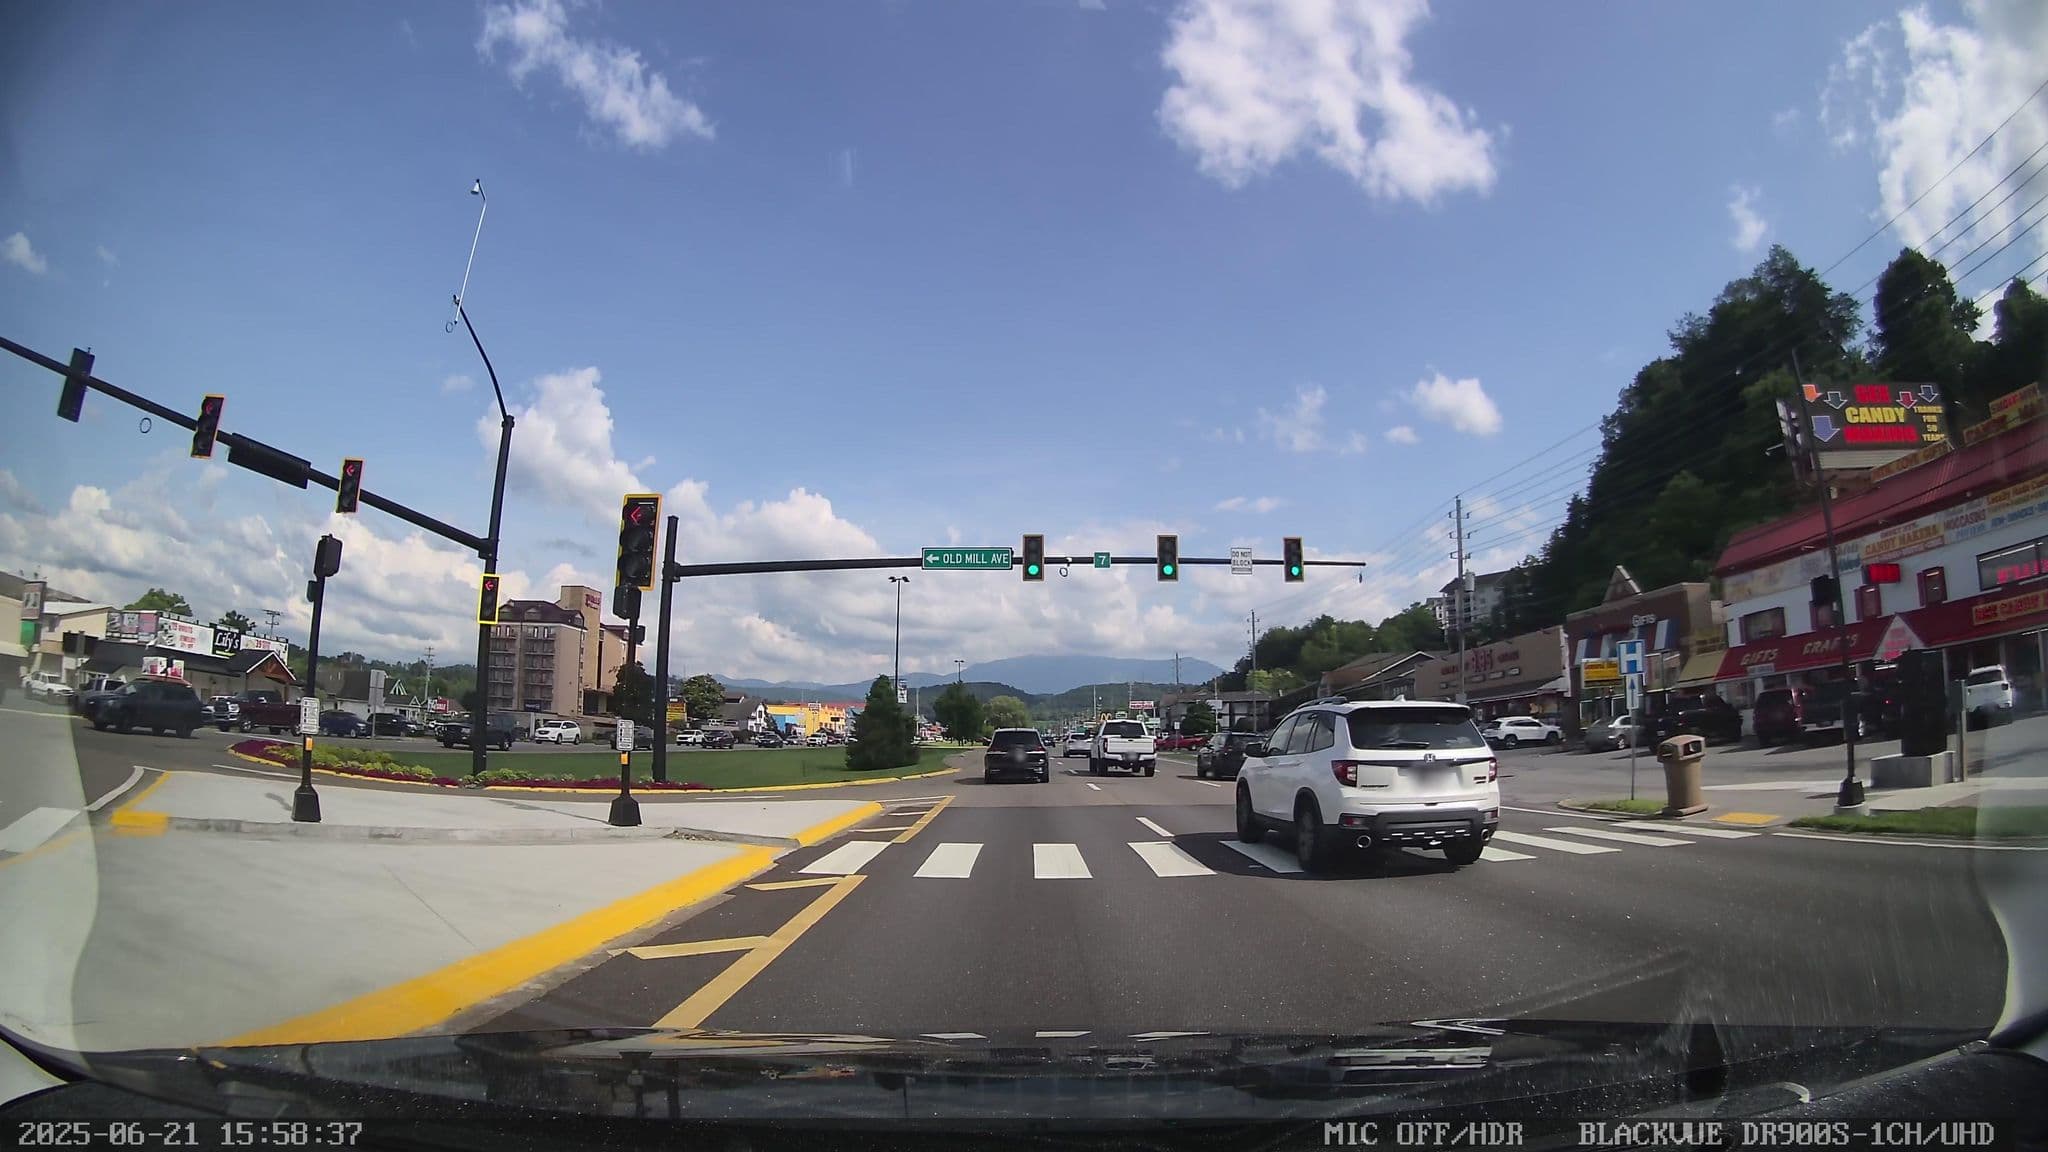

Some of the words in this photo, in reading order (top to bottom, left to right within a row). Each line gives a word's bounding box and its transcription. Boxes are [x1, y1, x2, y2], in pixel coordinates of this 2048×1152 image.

[1845, 407, 1904, 423] CANDY
[942, 553, 961, 563] OLD
[964, 553, 987, 563] MILL
[990, 553, 1009, 563] AVE
[1098, 555, 1107, 565] 7
[214, 631, 239, 652] Lily's
[1619, 643, 1643, 673] H
[1740, 648, 1779, 666] GIFTS
